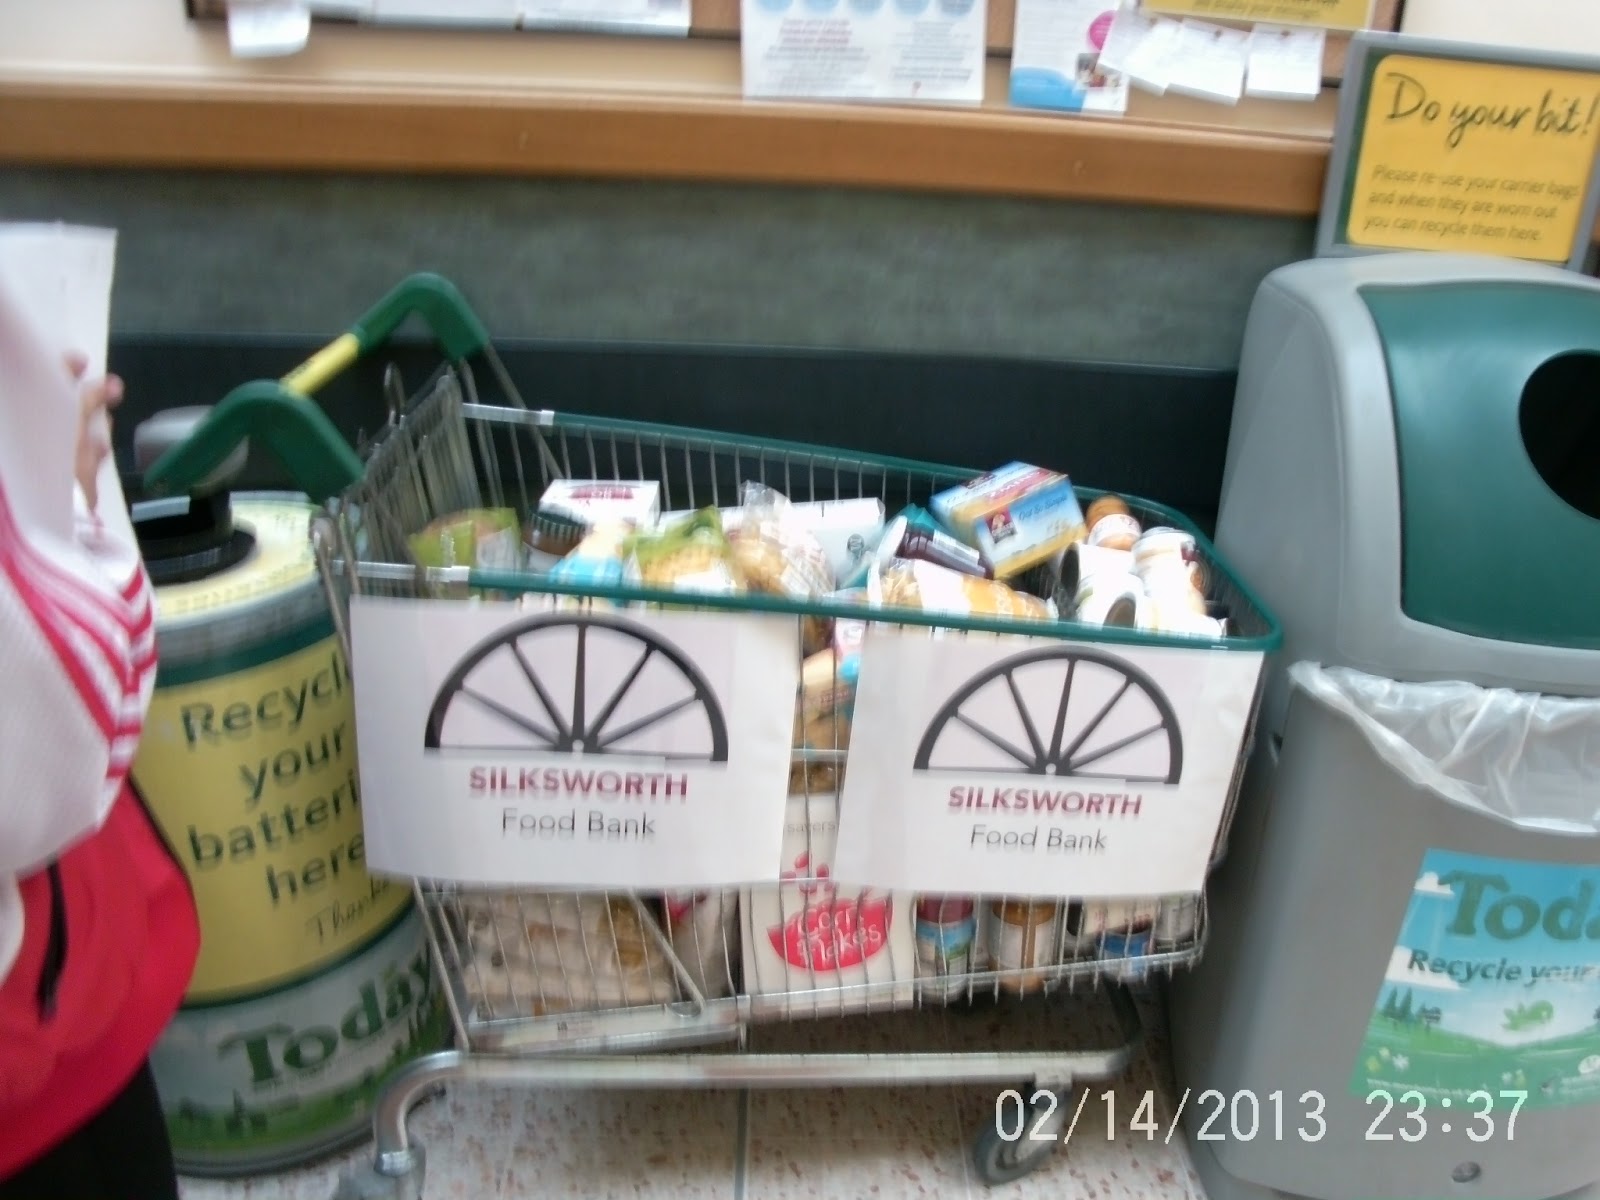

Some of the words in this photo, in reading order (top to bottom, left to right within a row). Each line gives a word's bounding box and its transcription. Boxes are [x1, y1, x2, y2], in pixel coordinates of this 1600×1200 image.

[1385, 72, 1441, 121] Do
[1445, 100, 1532, 149] your
[1533, 88, 1600, 134] bit!
[1372, 164, 1418, 183] Please
[1465, 177, 1499, 193] your
[1368, 190, 1396, 205] and
[1398, 193, 1436, 208] when
[1437, 196, 1469, 216] they
[1471, 200, 1495, 213] are
[1533, 205, 1558, 219] out
[1363, 216, 1391, 232] you
[1392, 217, 1418, 230] can
[1420, 220, 1468, 237] recycle
[1471, 223, 1507, 237] them
[180, 651, 352, 748] Recycl
[239, 721, 345, 804] your
[468, 765, 688, 798] SILKSWORTH
[948, 786, 1143, 816] SILKSWORTH
[186, 770, 359, 866] batteri
[502, 807, 576, 836] Food
[588, 810, 656, 839] Bank
[970, 824, 1039, 850] Food
[1047, 828, 1108, 851] Bank
[265, 832, 365, 905] here
[1407, 949, 1522, 984] Recycle
